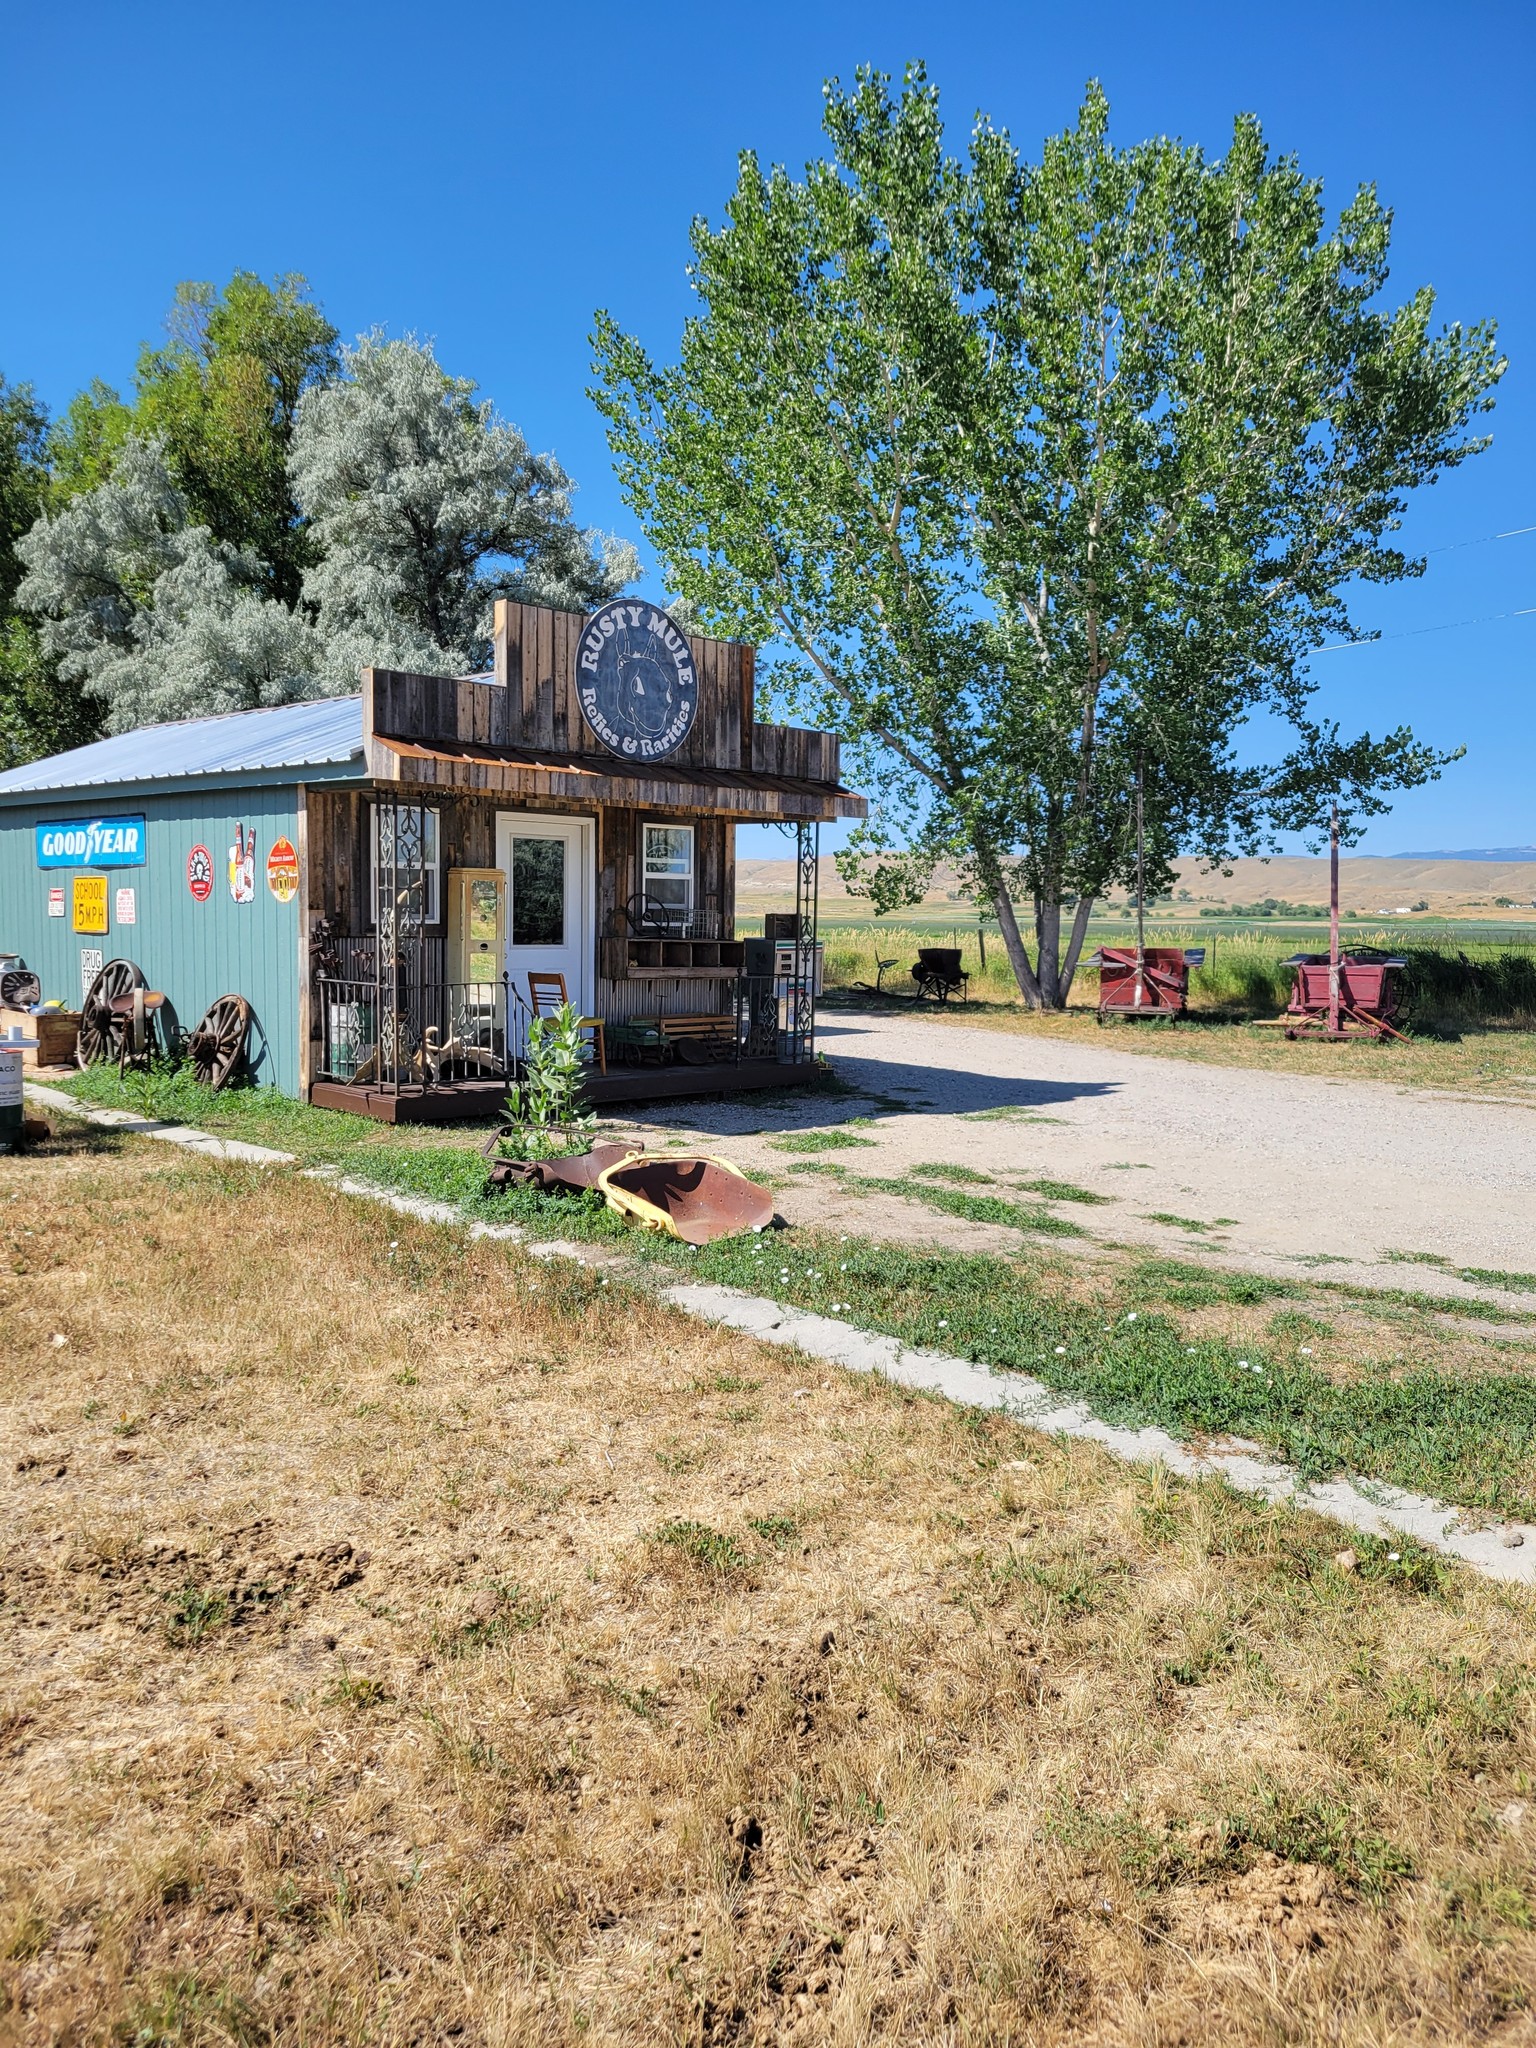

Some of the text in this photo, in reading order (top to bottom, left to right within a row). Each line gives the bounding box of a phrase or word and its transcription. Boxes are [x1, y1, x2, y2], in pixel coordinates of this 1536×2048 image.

[581, 606, 693, 686] RUSTY MULE
[582, 688, 691, 756] Relics & Rarities
[42, 824, 139, 859] GOODYEAR
[75, 882, 104, 900] SCHOOL
[74, 903, 85, 926] 15
[82, 950, 101, 969] DRUG
